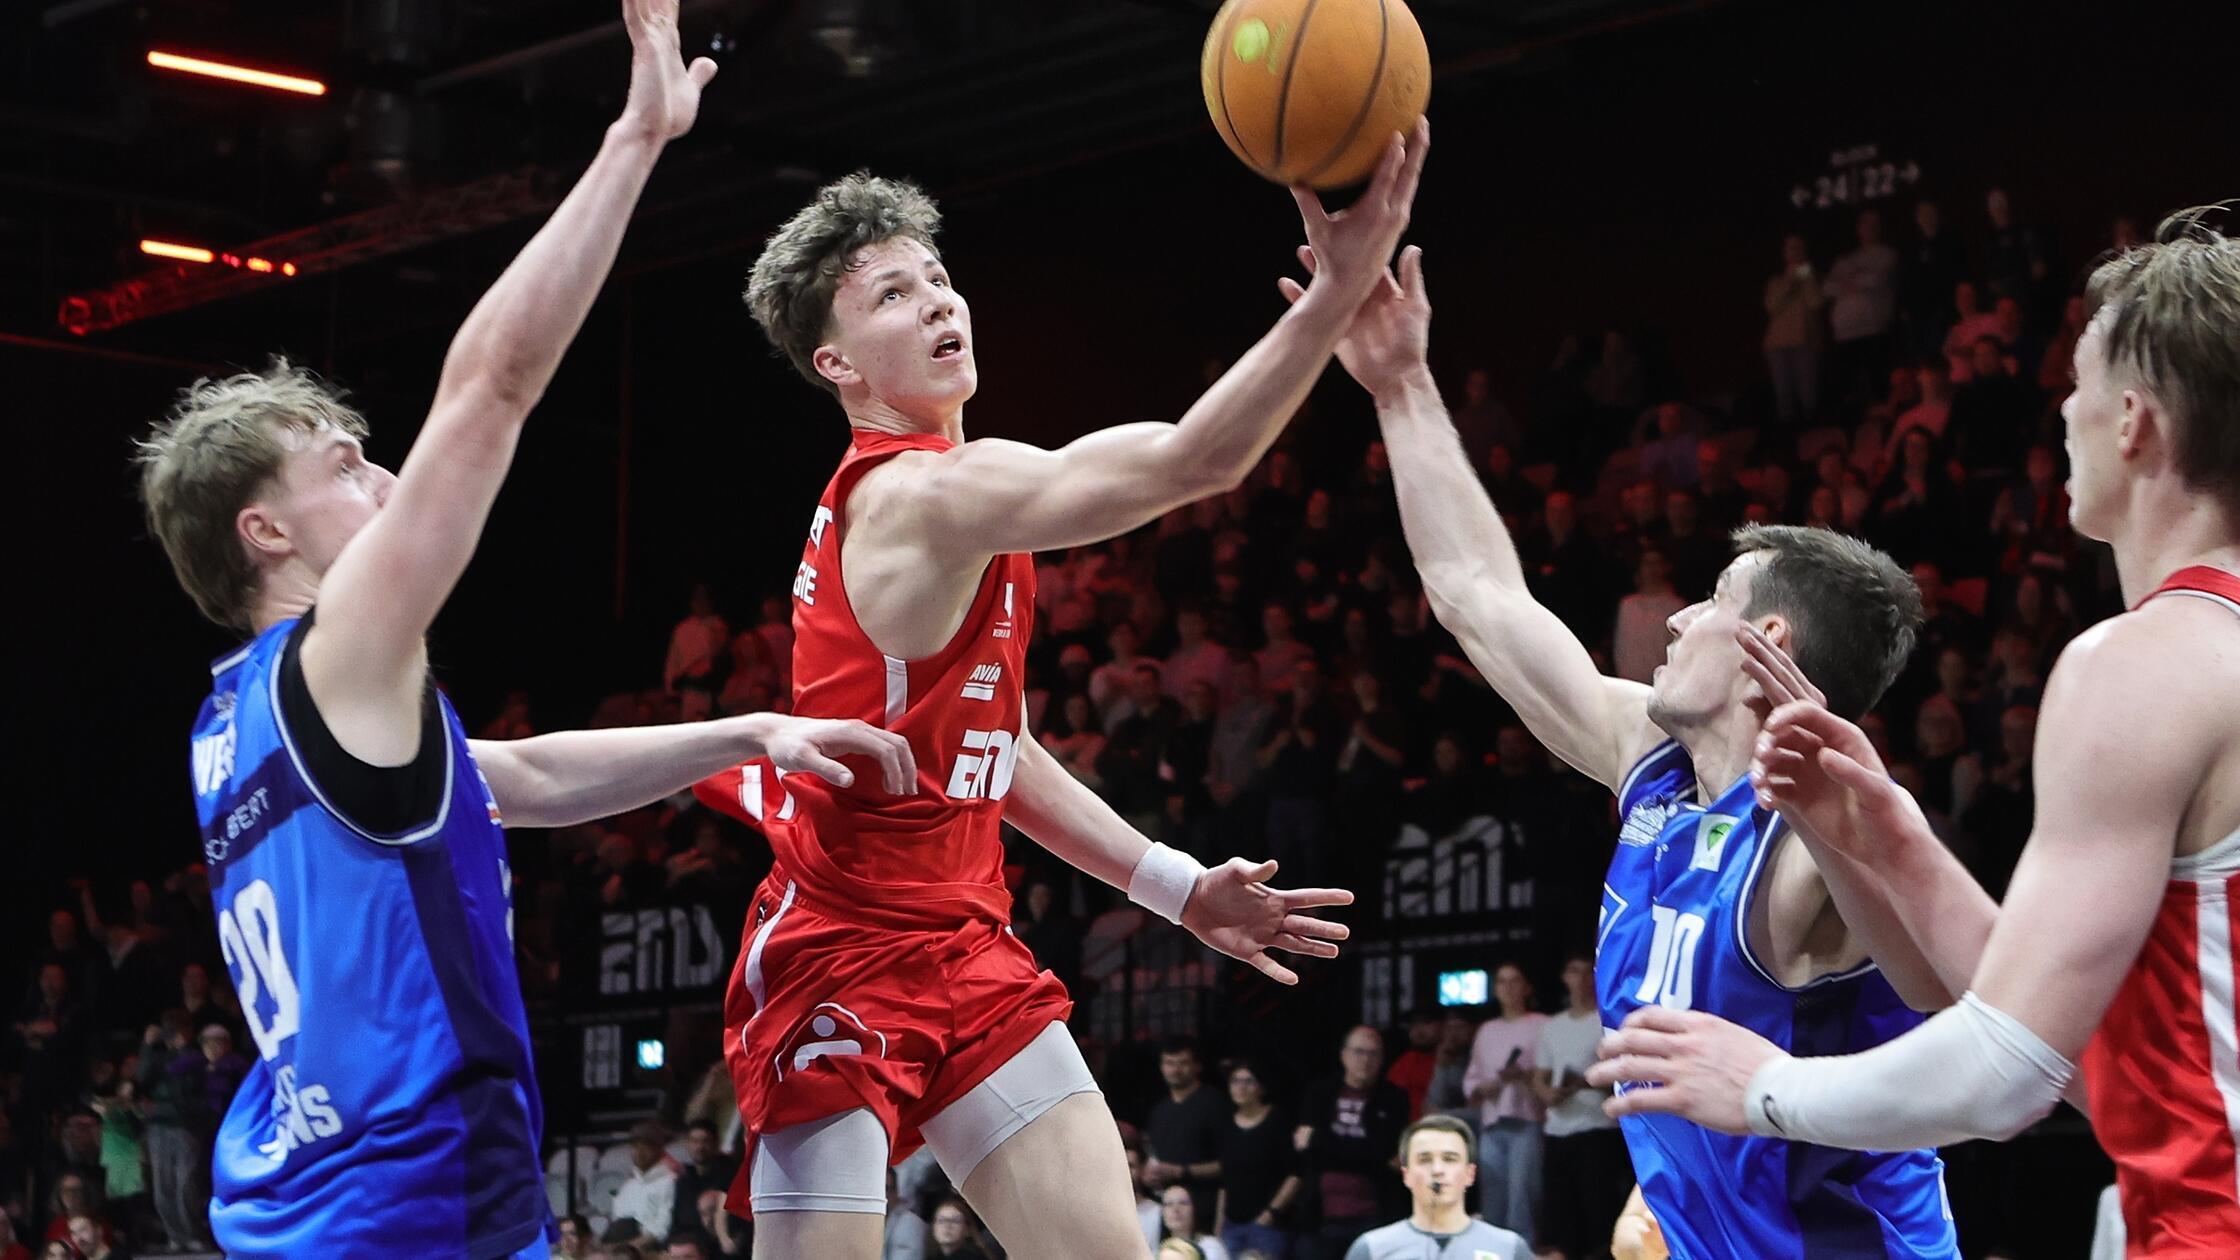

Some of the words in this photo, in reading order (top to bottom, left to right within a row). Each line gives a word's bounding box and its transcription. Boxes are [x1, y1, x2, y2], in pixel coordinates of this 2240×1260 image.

[1863, 163, 1896, 199] 22
[219, 879, 300, 1062] 20
[1636, 904, 1705, 1010] 10
